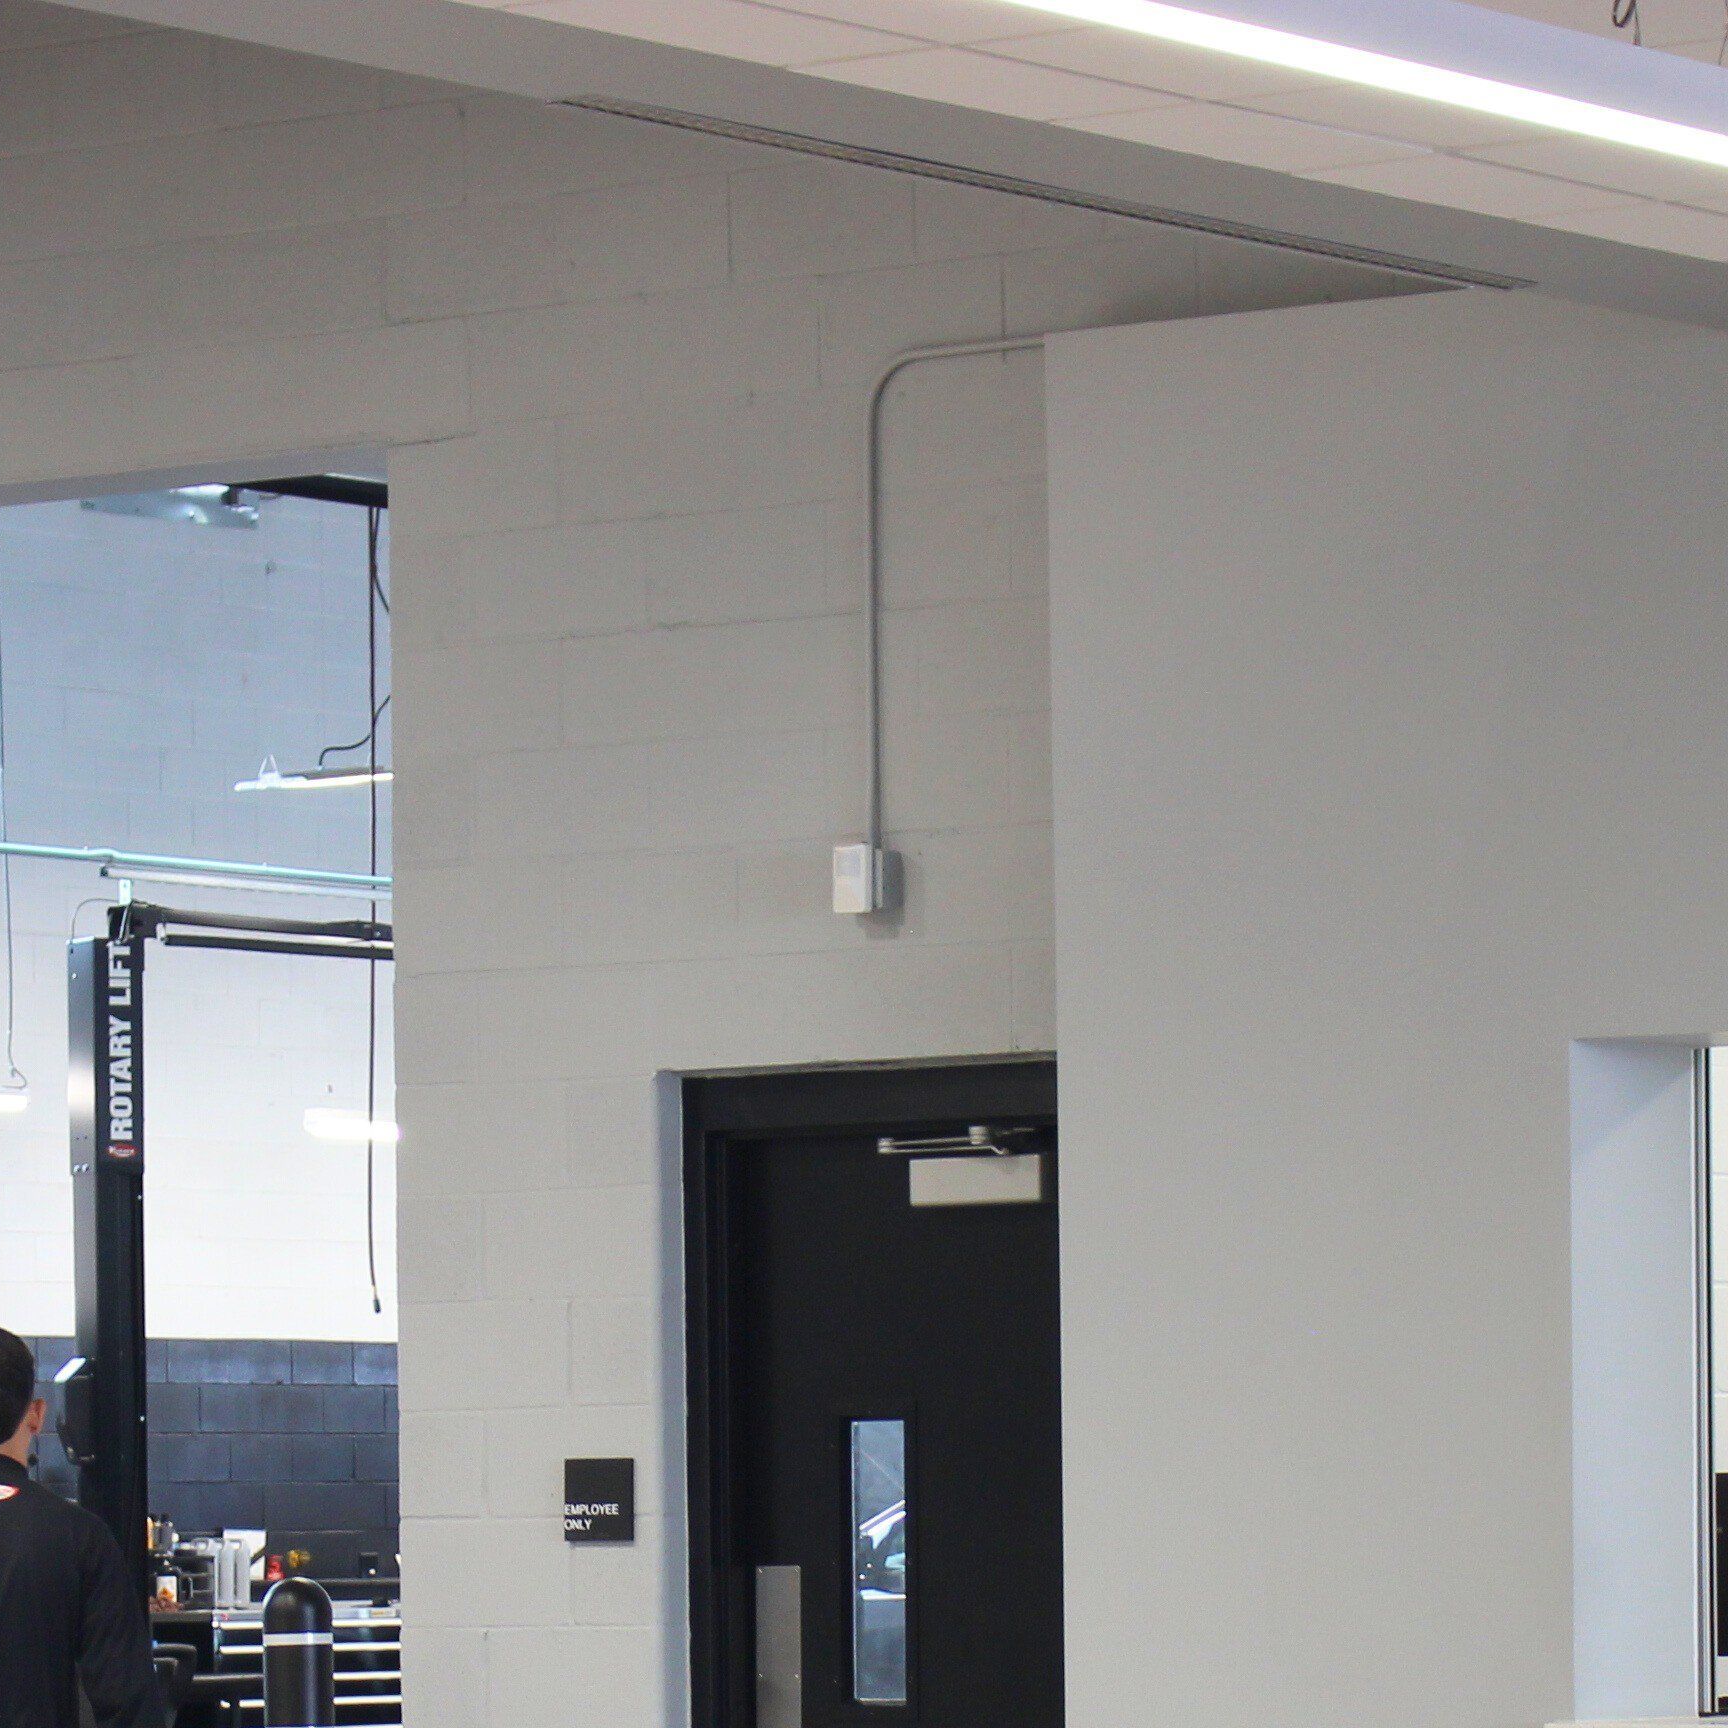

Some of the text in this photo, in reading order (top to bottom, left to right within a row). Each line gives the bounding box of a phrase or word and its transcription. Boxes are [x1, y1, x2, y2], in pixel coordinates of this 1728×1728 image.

[108, 941, 132, 1006] LIFT
[109, 1014, 133, 1140] ROTARY
[564, 1503, 619, 1515] EMPLOYEE
[564, 1518, 592, 1530] ONLY
